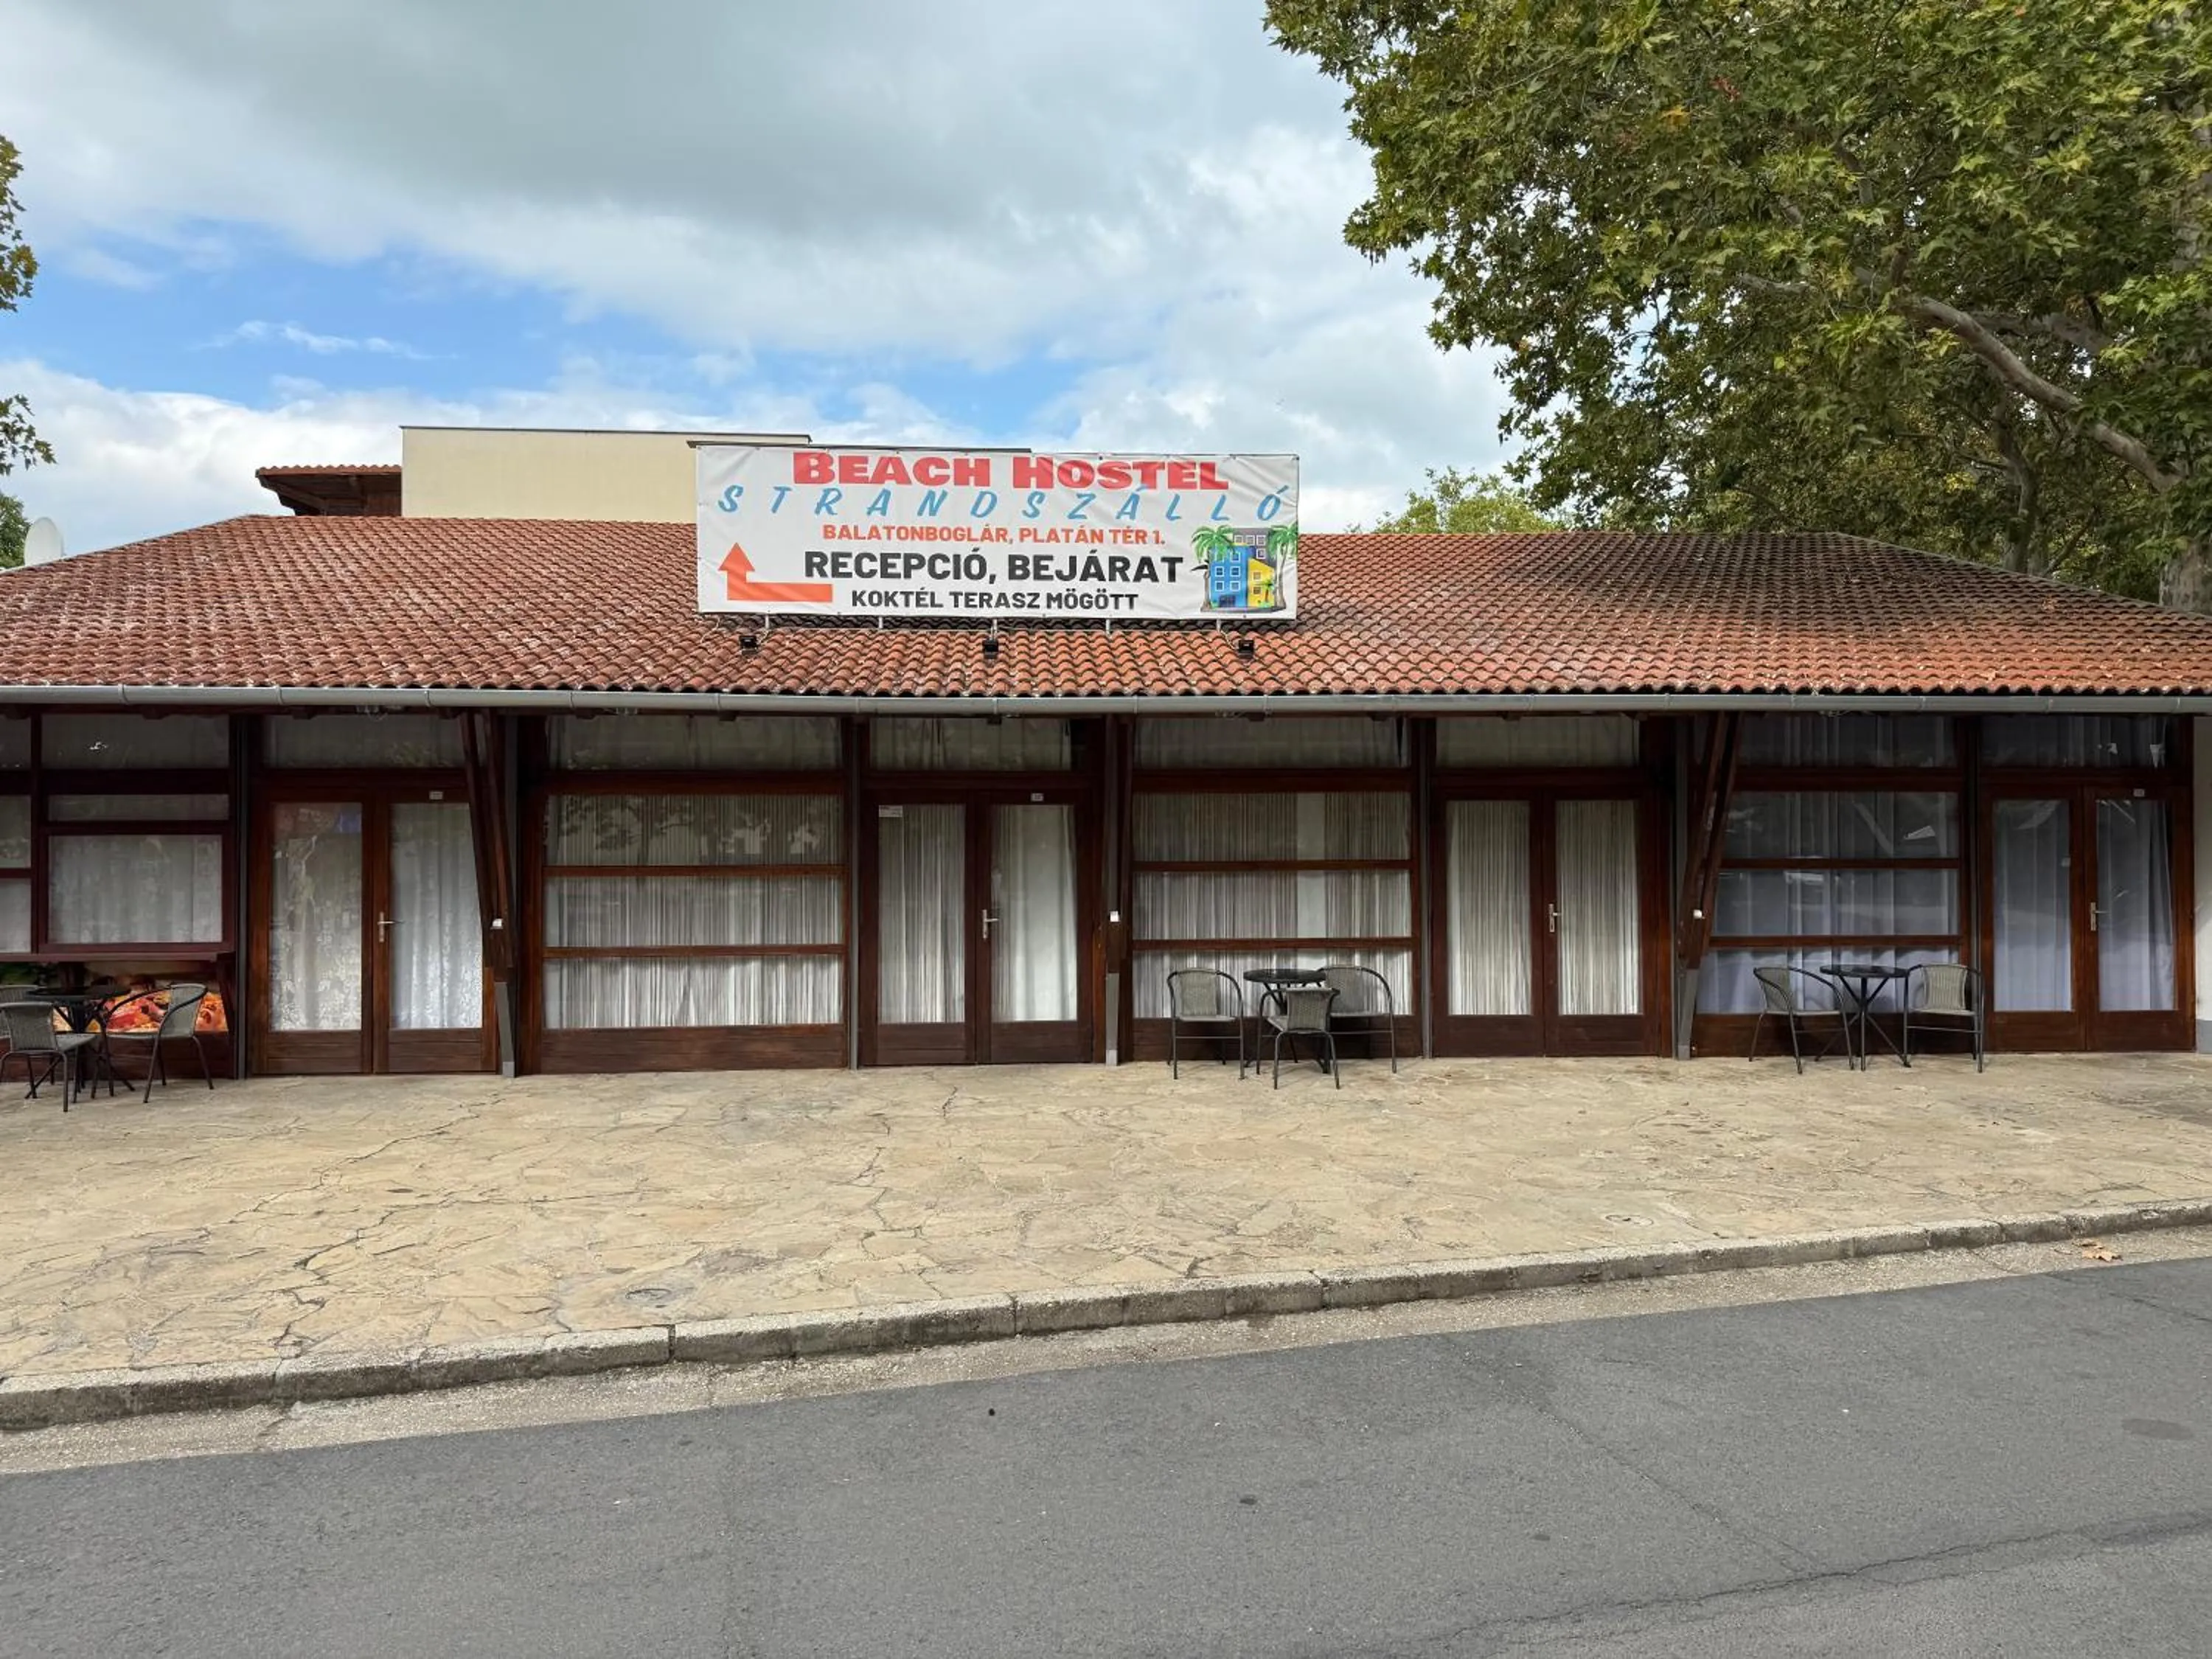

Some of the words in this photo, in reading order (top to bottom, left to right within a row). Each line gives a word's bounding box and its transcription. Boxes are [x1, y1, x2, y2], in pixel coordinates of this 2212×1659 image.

[793, 452, 990, 487] BEACH
[1012, 456, 1228, 490] HOSTEL
[717, 484, 1289, 521] STRANDSZÁLLÓ
[823, 524, 1013, 544] BALATONBOGLÁR,
[1019, 524, 1104, 544] PLATÁN
[1109, 526, 1148, 545] TÉR
[1152, 530, 1165, 545] 1.
[805, 548, 996, 584] RECEPCIÓ,
[1008, 549, 1183, 583] BEJÁRAT
[852, 587, 943, 608] KOKTÉL
[950, 591, 1040, 609] TERASZ
[1046, 588, 1138, 611] MÖGÖTT
